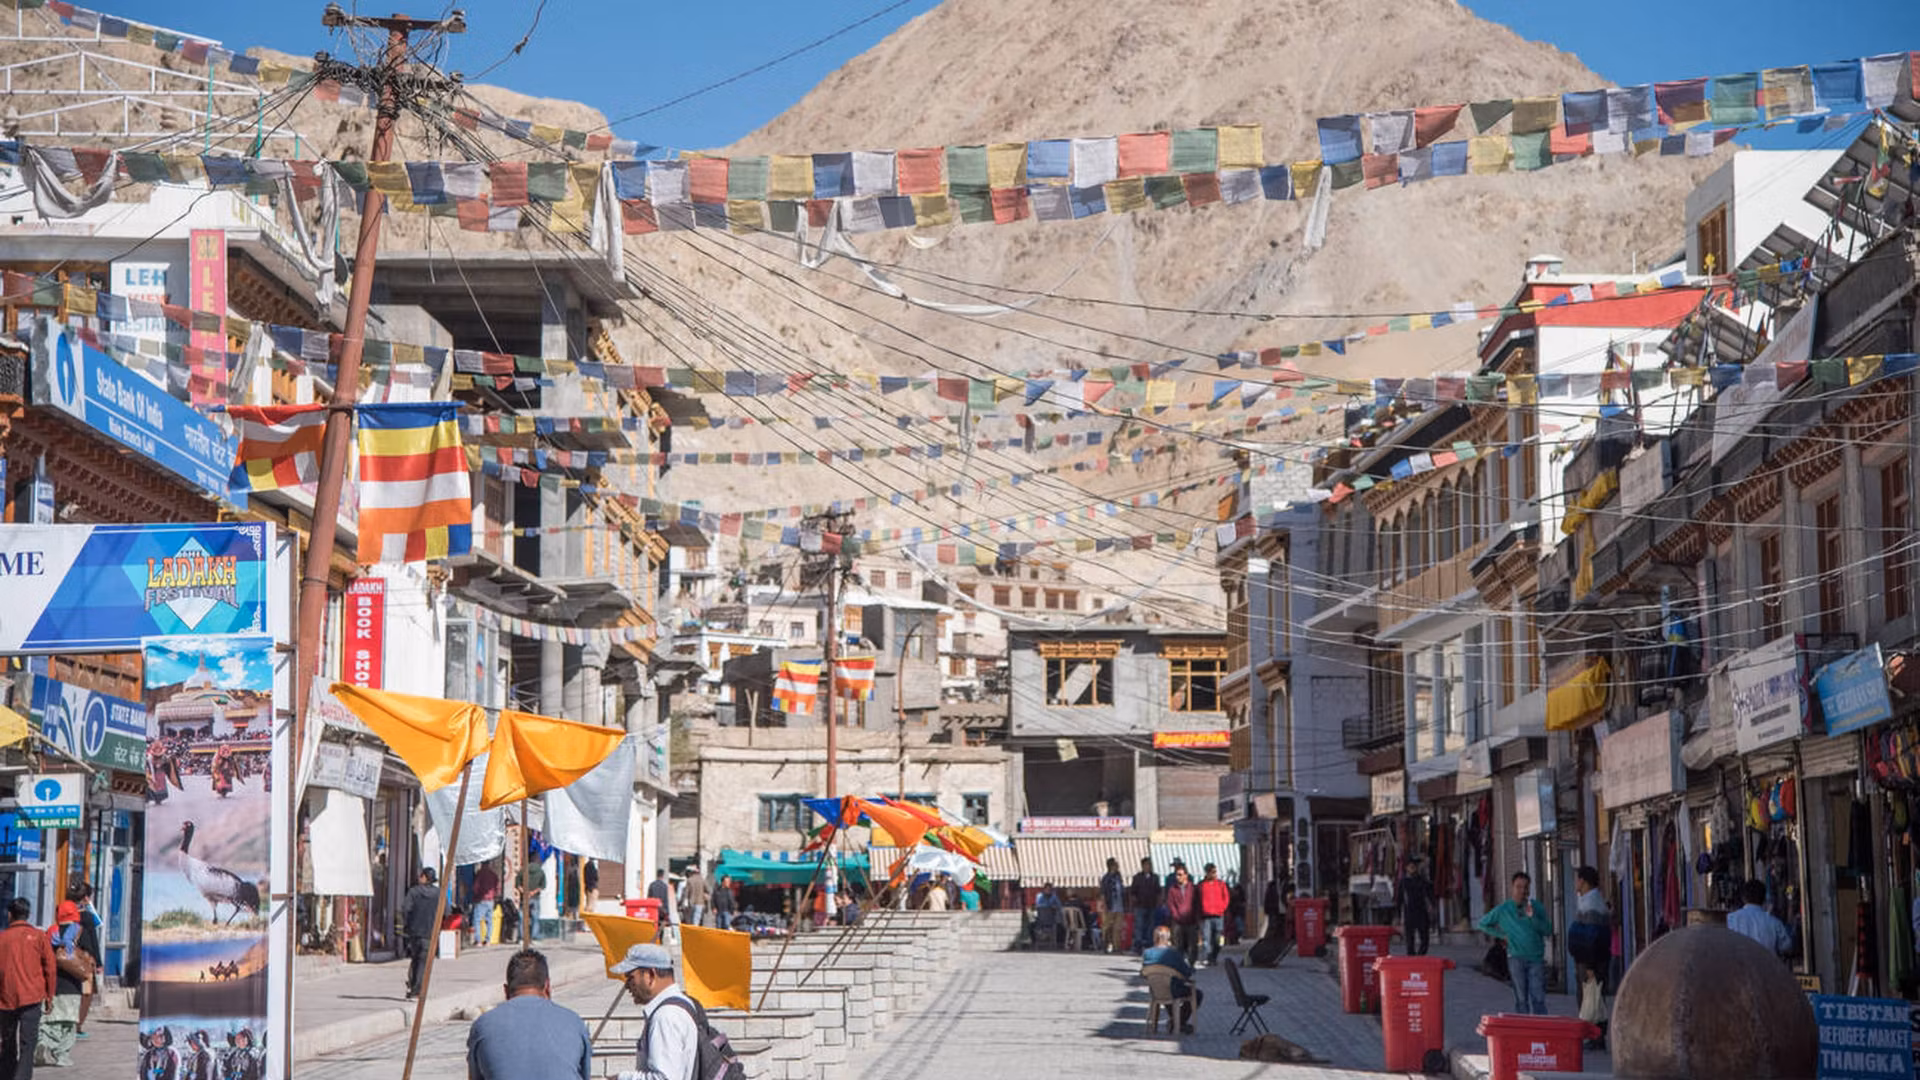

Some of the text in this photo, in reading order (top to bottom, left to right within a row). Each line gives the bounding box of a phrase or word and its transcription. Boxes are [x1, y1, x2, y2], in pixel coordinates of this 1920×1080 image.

[125, 268, 166, 286] LEH
[97, 367, 117, 404] State
[117, 379, 135, 415] Bank
[146, 396, 164, 431] India
[146, 555, 237, 589] LADAKH
[143, 586, 240, 612] FESTIVAL
[347, 582, 383, 594] LADAKH
[356, 596, 373, 640] BOOK
[110, 703, 130, 726] STATE
[41, 818, 61, 827] BANK
[1819, 1002, 1909, 1023] TIBETAN
[1819, 1026, 1908, 1049] REFUGEE MARKET
[1820, 1051, 1905, 1073] THANGKA
